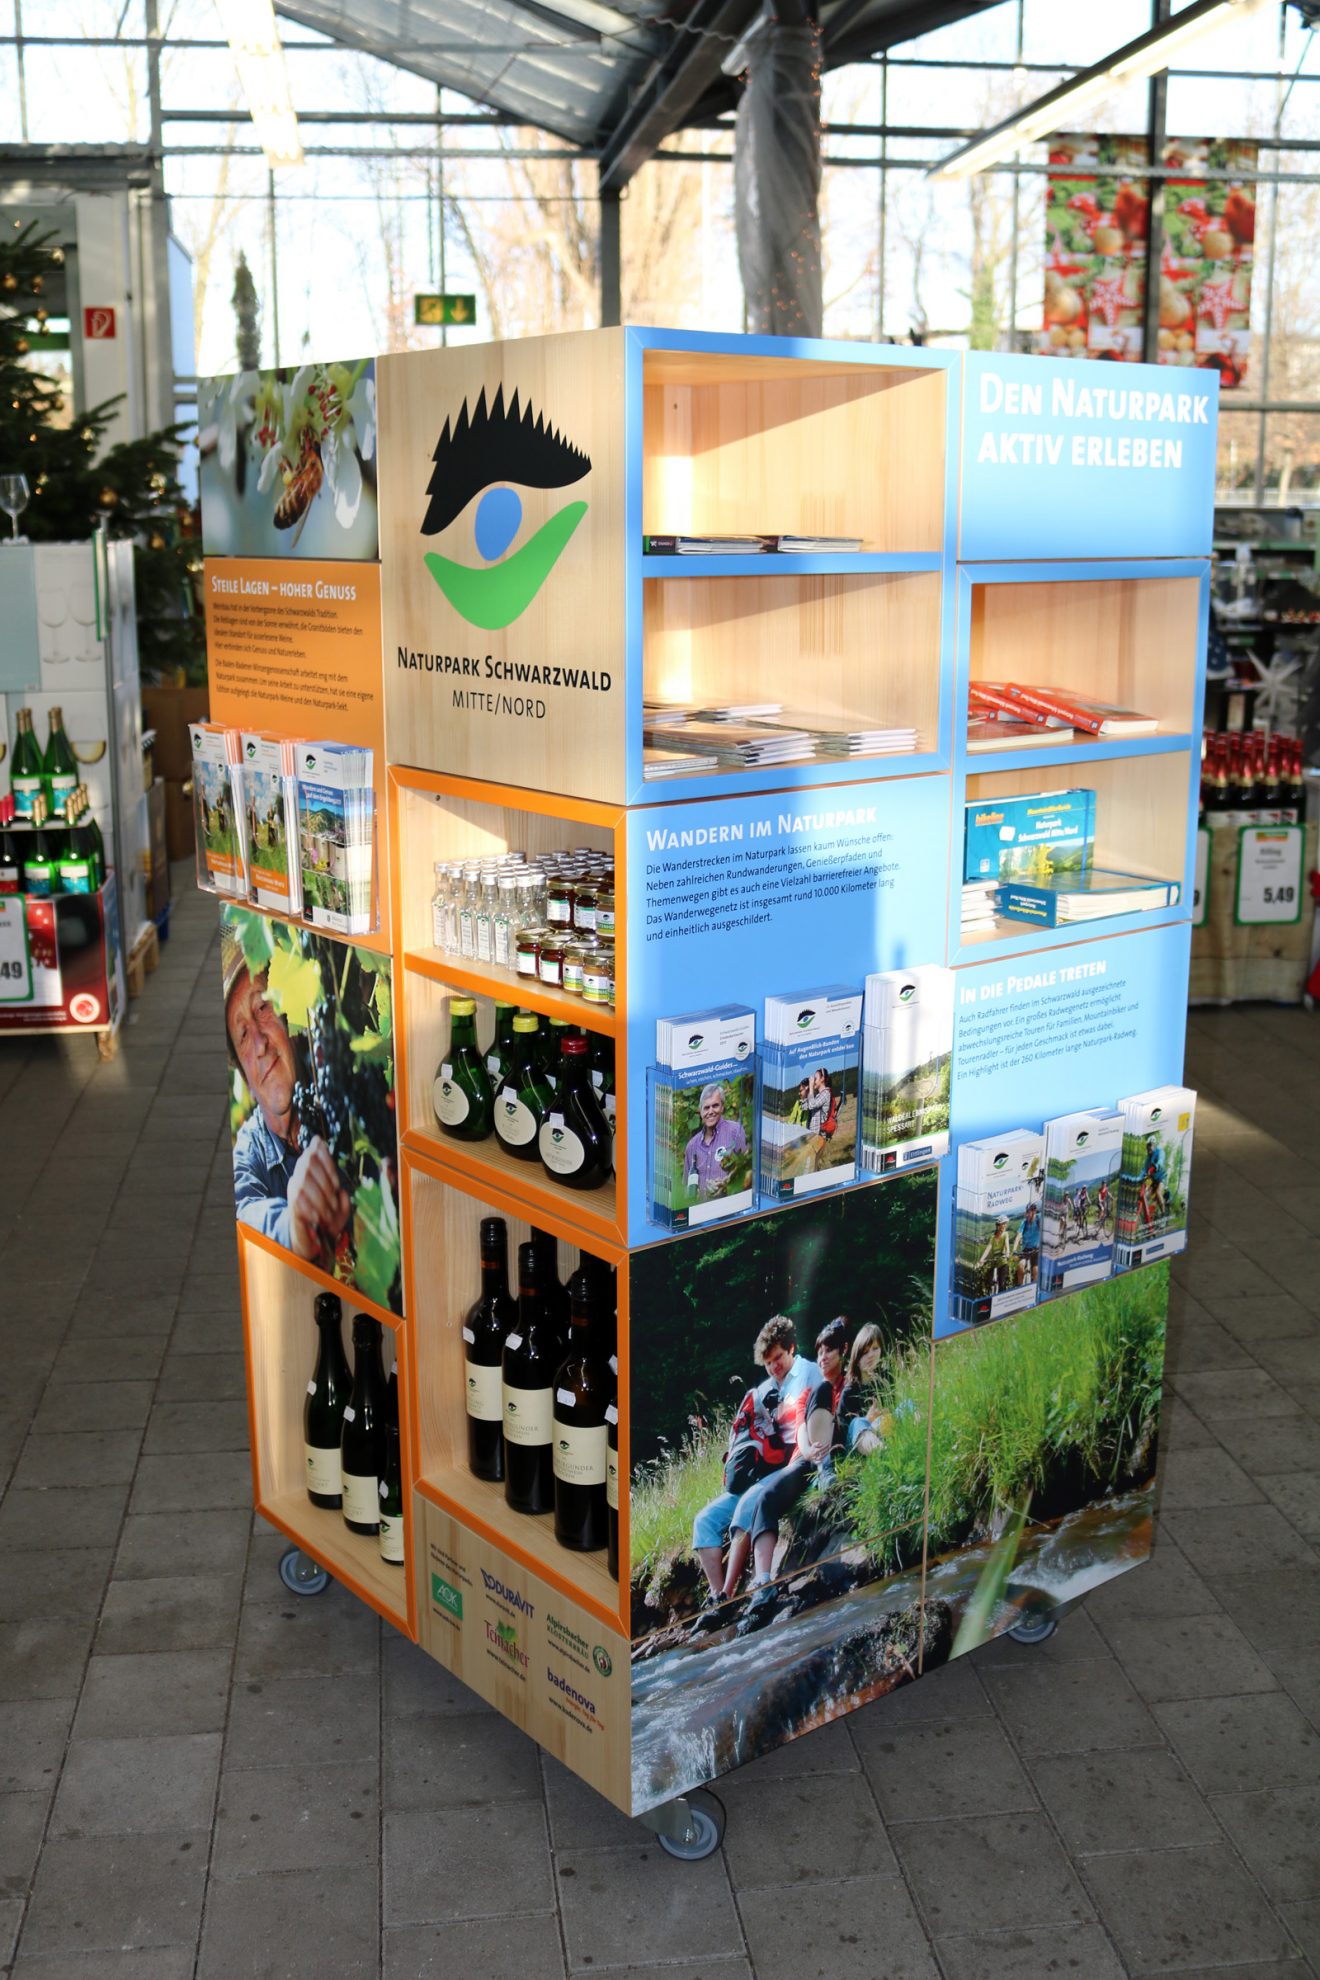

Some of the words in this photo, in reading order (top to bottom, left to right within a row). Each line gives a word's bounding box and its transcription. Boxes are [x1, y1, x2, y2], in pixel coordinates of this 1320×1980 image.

[452, 690, 546, 718] MITTE/NORD
[646, 864, 661, 875] Die
[662, 856, 730, 872] Wanderstrecken
[732, 853, 743, 862] im
[745, 847, 786, 861] Naturpark
[787, 843, 812, 855] lassen
[813, 840, 835, 851] kaum
[836, 833, 871, 848] Wünsche
[646, 880, 675, 892] Neben
[676, 871, 725, 888] zahlreichen
[726, 861, 805, 880] Rundwanderungen,
[806, 851, 867, 869] Genießerpfaden
[868, 848, 882, 859] und
[646, 891, 710, 909] Themenwegen
[711, 887, 728, 900] gibt
[730, 887, 739, 896] es
[740, 882, 761, 894] auch
[762, 880, 779, 891] eine
[781, 874, 811, 888] Vielzahl
[812, 867, 862, 883] barrierefreier
[646, 914, 662, 925] Das
[664, 903, 737, 922] Wanderwegenetz
[739, 900, 749, 910] ist
[751, 893, 793, 909] insgesamt
[794, 890, 813, 902] rund
[814, 886, 839, 898] 10.000
[841, 880, 877, 894] Kilometer
[878, 877, 894, 889] lang
[1264, 886, 1294, 904] 5,49
[646, 929, 663, 942] und
[665, 922, 710, 939] einheitlich
[711, 912, 773, 931] ausgeschildert.
[959, 1014, 976, 1024] Auch
[977, 1006, 1008, 1019] Radfahrer
[1009, 1001, 1030, 1012] finden
[1031, 999, 1040, 1007] im
[1040, 989, 1080, 1005] Schwarzwald
[1024, 1024, 1045, 1036] Touren
[1046, 1021, 1056, 1032] für
[1127, 1002, 1139, 1011] und
[959, 1021, 1002, 1038] Bedingungen
[1015, 1015, 1025, 1025] Ein
[1033, 1031, 1068, 1047] Geschmack
[1069, 1030, 1078, 1039] ist
[957, 1071, 967, 1080] Ein
[969, 1062, 999, 1079] Highlight
[1000, 1059, 1008, 1069] ist
[1009, 1055, 1021, 1067] der
[1021, 1053, 1033, 1064] 260
[1034, 1044, 1064, 1060] Kilometer
[547, 1614, 589, 1650] Alpirsbacher
[547, 1667, 596, 1714] badenova
